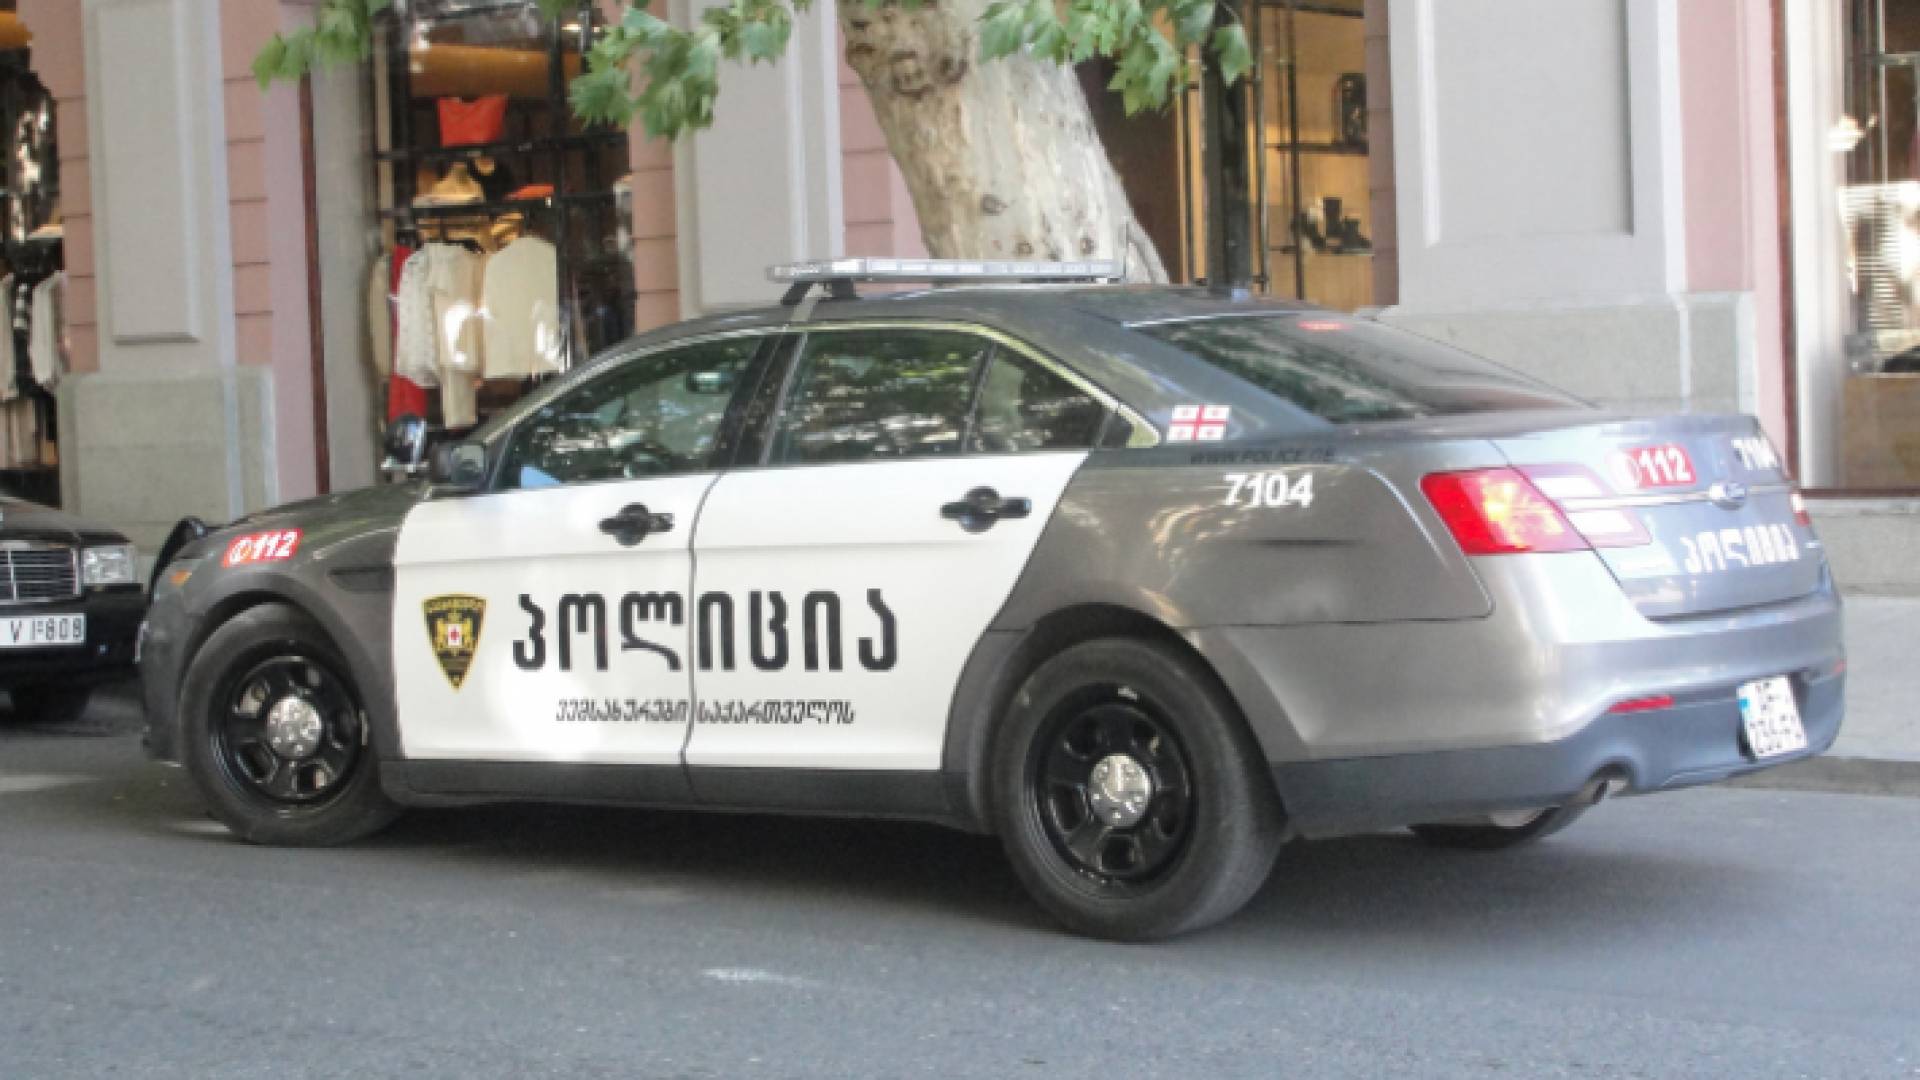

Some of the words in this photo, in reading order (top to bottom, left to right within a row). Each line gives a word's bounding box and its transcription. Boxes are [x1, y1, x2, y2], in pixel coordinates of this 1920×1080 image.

[1639, 446, 1691, 483] 112
[1223, 473, 1313, 507] 7104
[254, 531, 297, 559] 112
[512, 588, 897, 671] პოლიცია
